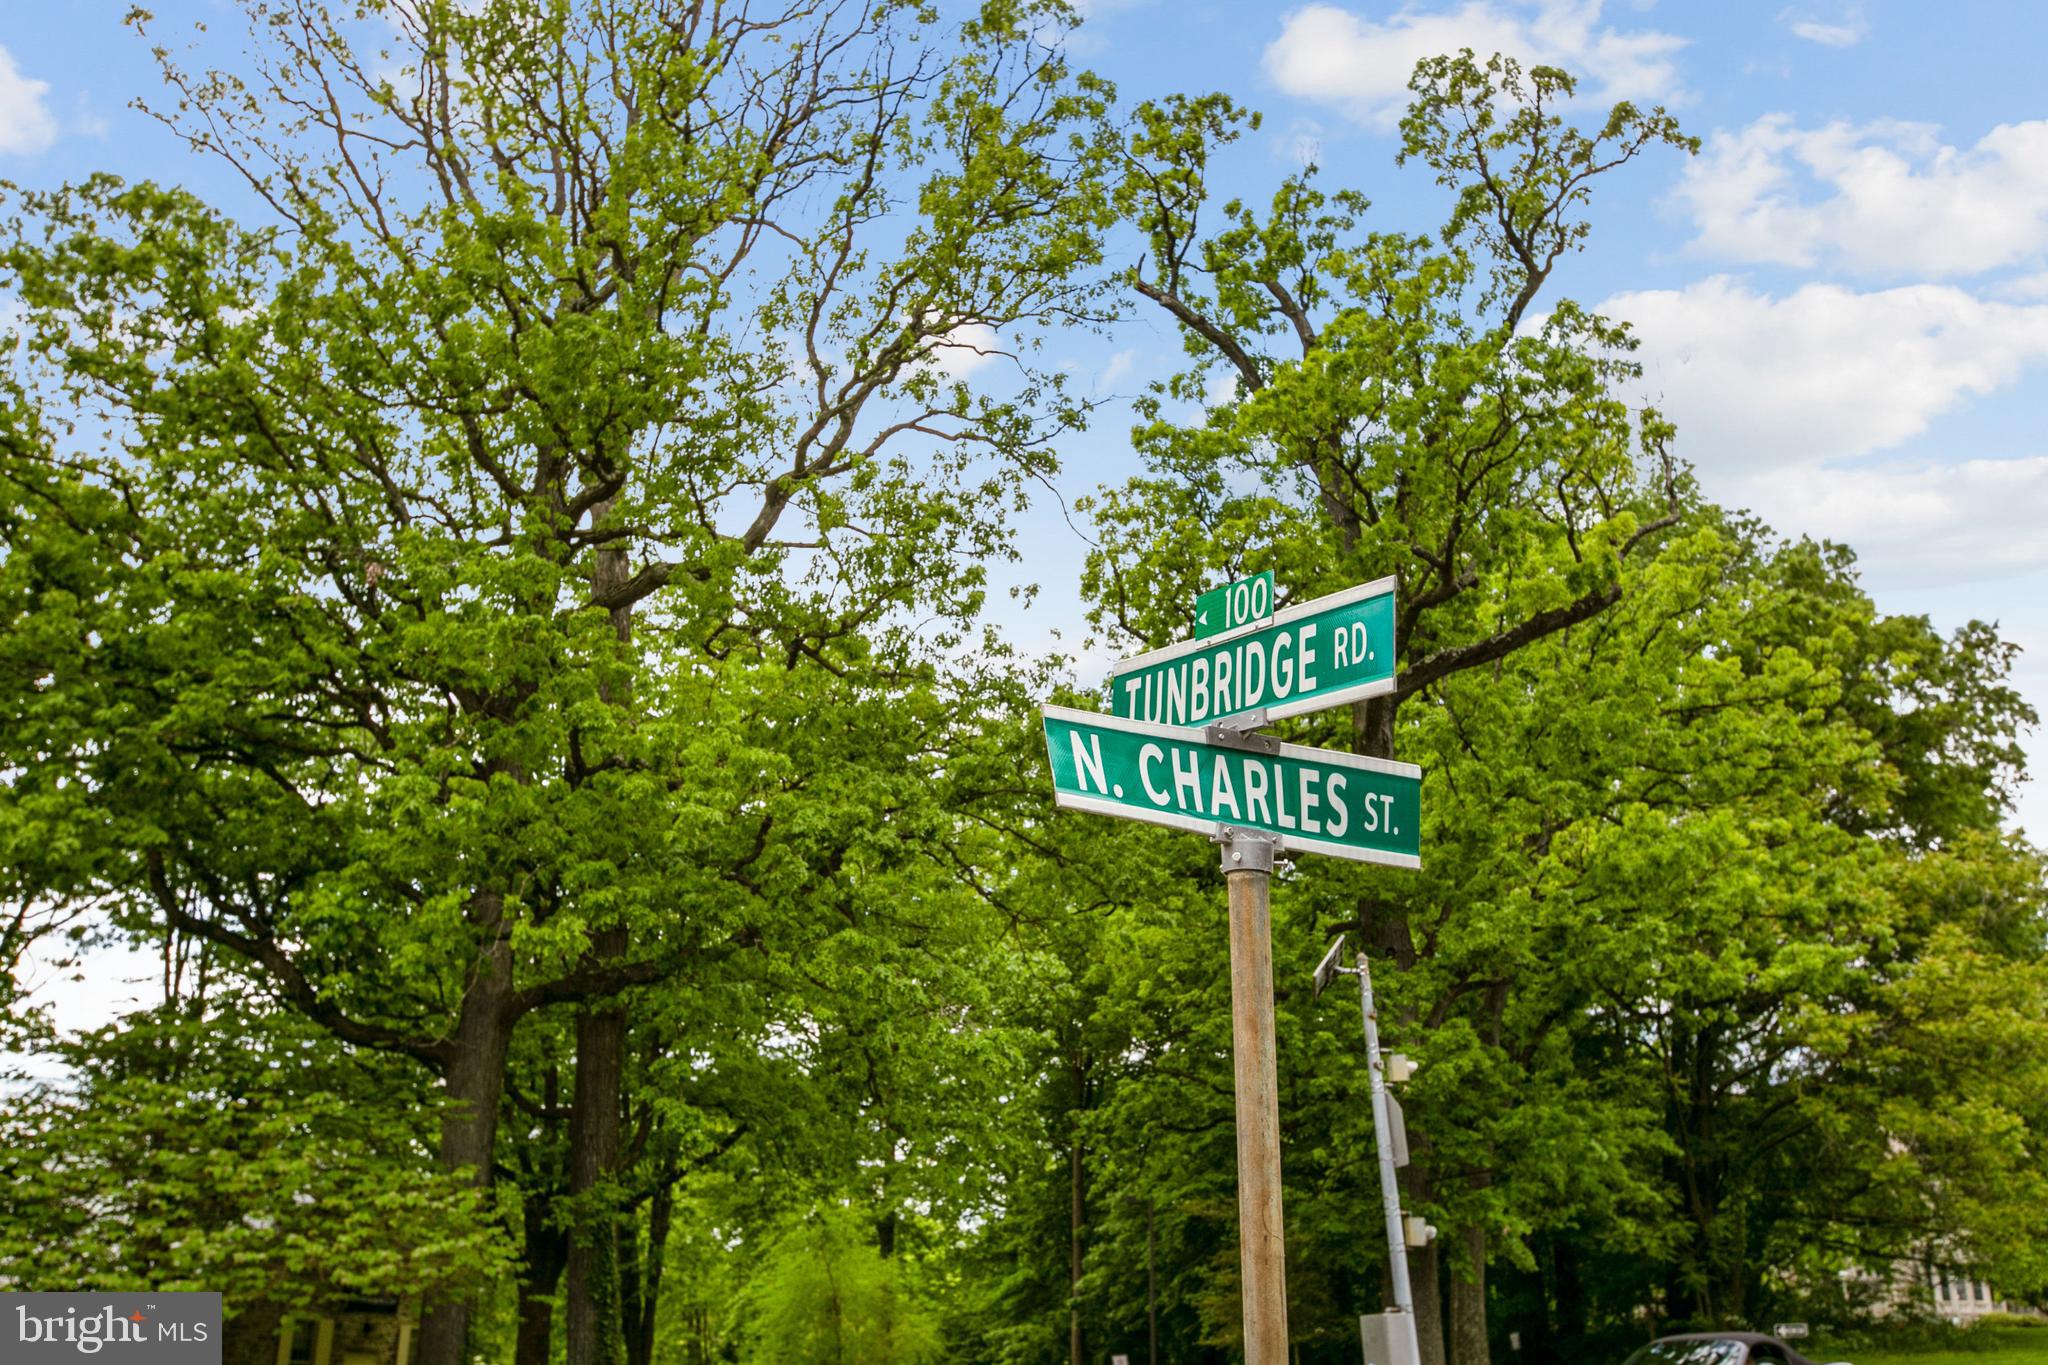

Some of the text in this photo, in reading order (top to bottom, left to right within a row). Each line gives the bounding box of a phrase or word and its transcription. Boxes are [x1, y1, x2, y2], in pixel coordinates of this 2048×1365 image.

[1224, 576, 1268, 629] 100
[1125, 621, 1375, 726] TUNBRIDGE RD.
[1069, 730, 1400, 838] N. CHARLES ST.
